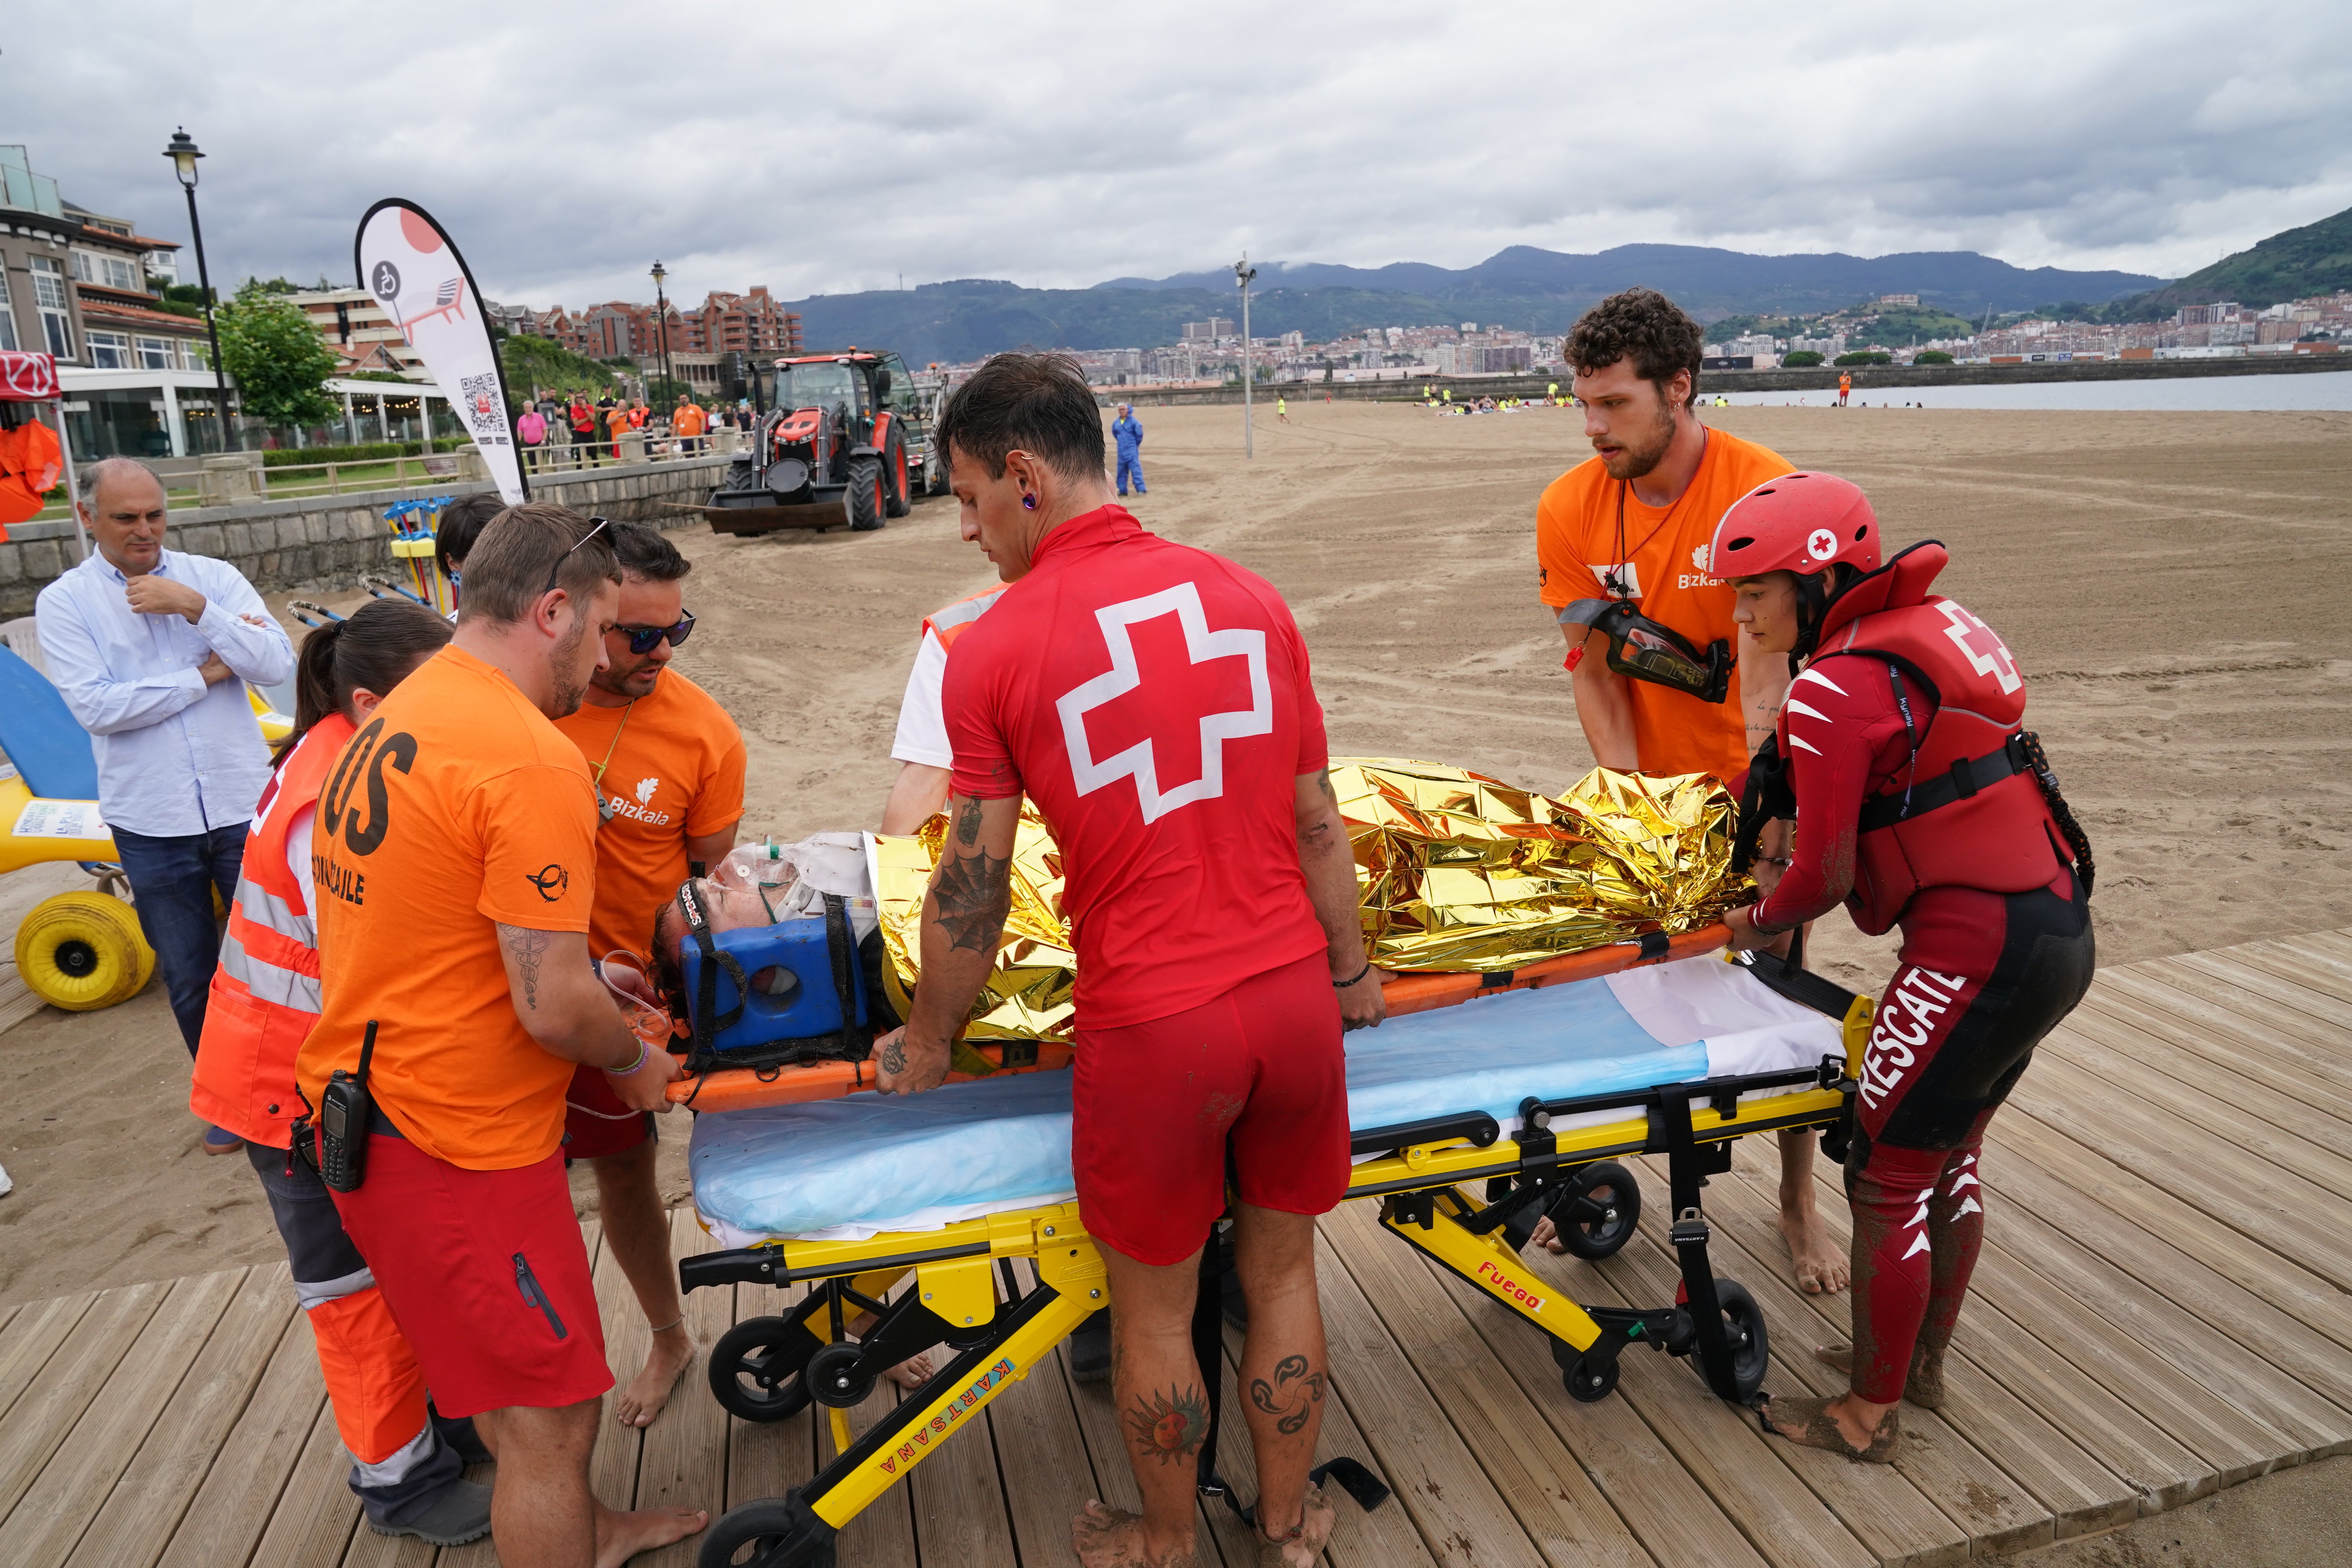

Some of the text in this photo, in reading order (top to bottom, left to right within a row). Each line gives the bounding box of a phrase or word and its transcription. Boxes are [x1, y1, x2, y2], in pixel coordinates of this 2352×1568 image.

[1899, 697, 1913, 727] kynay
[610, 796, 669, 826] Bizkaia
[880, 1360, 1011, 1474] KARTSANA
